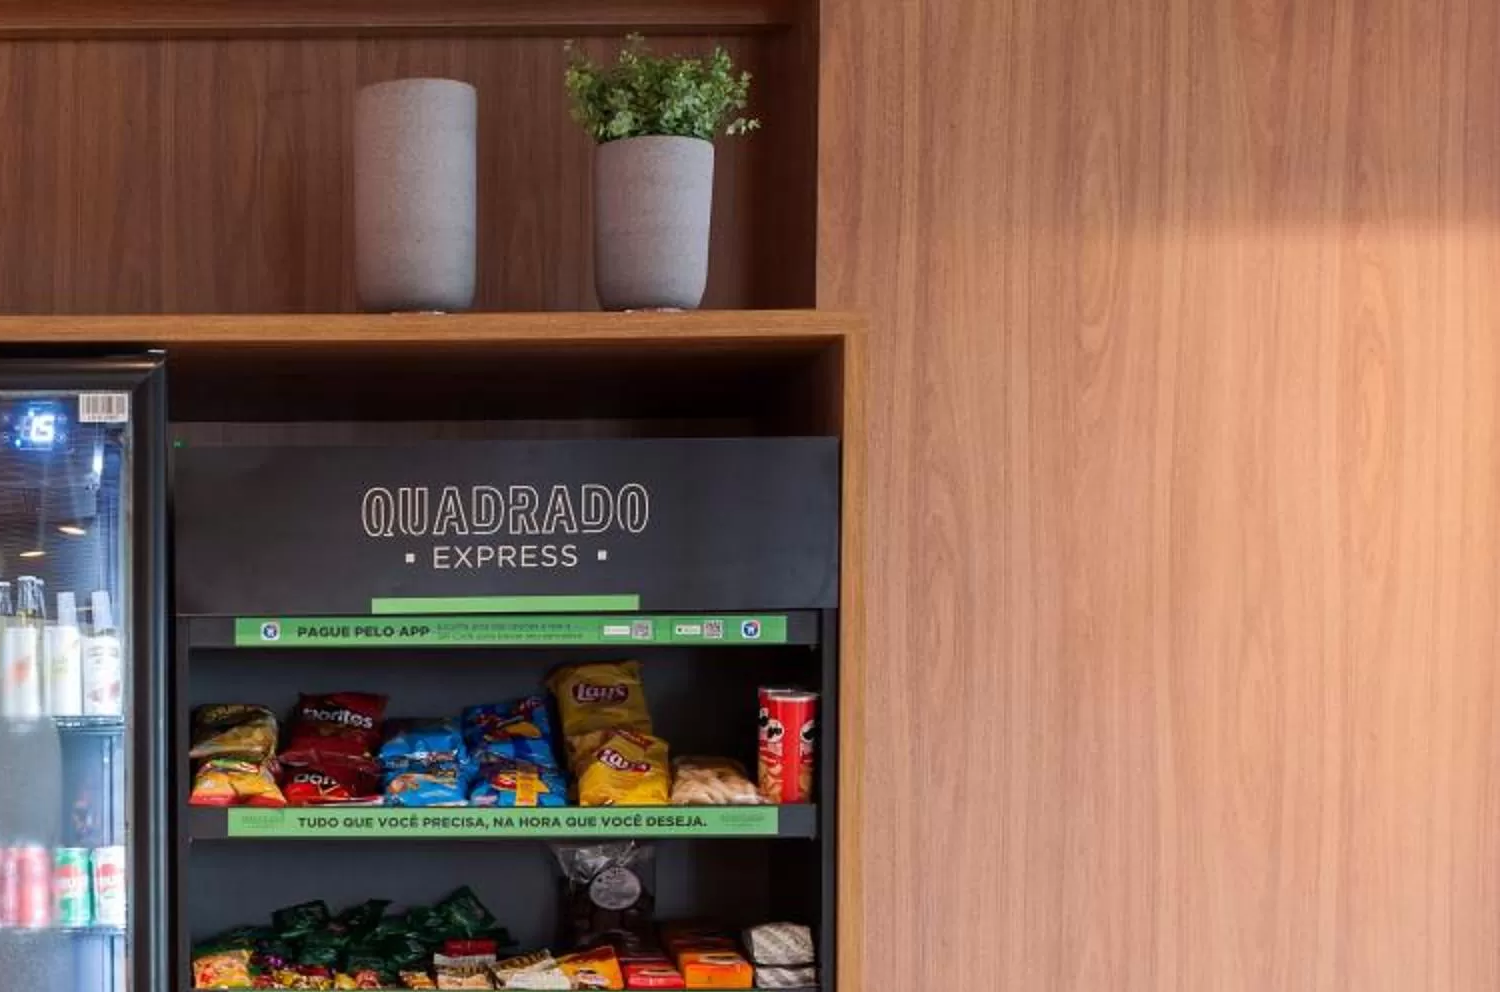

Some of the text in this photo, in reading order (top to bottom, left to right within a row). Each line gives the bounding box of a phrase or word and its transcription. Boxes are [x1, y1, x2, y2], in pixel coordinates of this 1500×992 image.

[361, 483, 649, 537] QUADRADO
[432, 544, 579, 569] EXPRESS
[297, 625, 350, 638] PAGUE
[355, 625, 395, 637] PELO
[399, 625, 430, 637] APP
[297, 816, 339, 829] TUDO
[342, 816, 374, 829] QUE
[378, 813, 419, 828] VOCÊ
[422, 816, 490, 830] PRECISA,
[493, 816, 515, 828] NA
[519, 816, 561, 828] HORA
[565, 816, 597, 828] QUE
[601, 813, 642, 828] VOCÊ
[645, 815, 708, 828] DESEJA.
